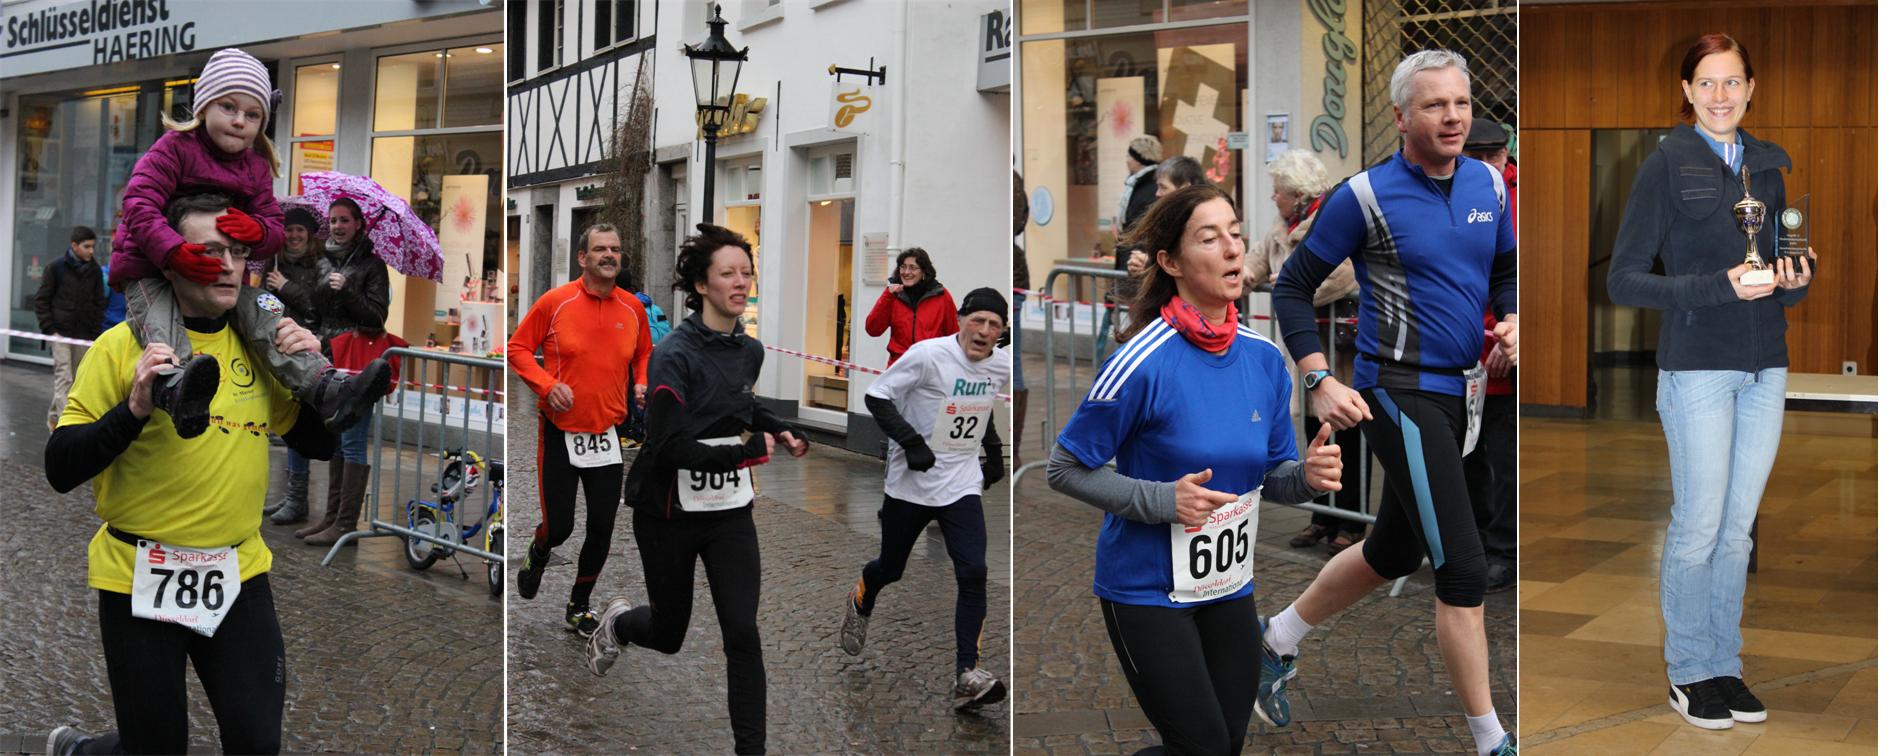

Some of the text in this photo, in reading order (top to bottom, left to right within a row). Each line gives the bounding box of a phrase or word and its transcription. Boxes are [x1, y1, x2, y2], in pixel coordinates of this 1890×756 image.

[7, 0, 170, 48] Schlüsseldienst
[94, 22, 195, 64] HAERING
[574, 433, 612, 456] 845
[949, 416, 978, 439] 32
[1209, 499, 1253, 524] Sparkasse
[1189, 519, 1249, 579] 605
[150, 568, 224, 610] 786
